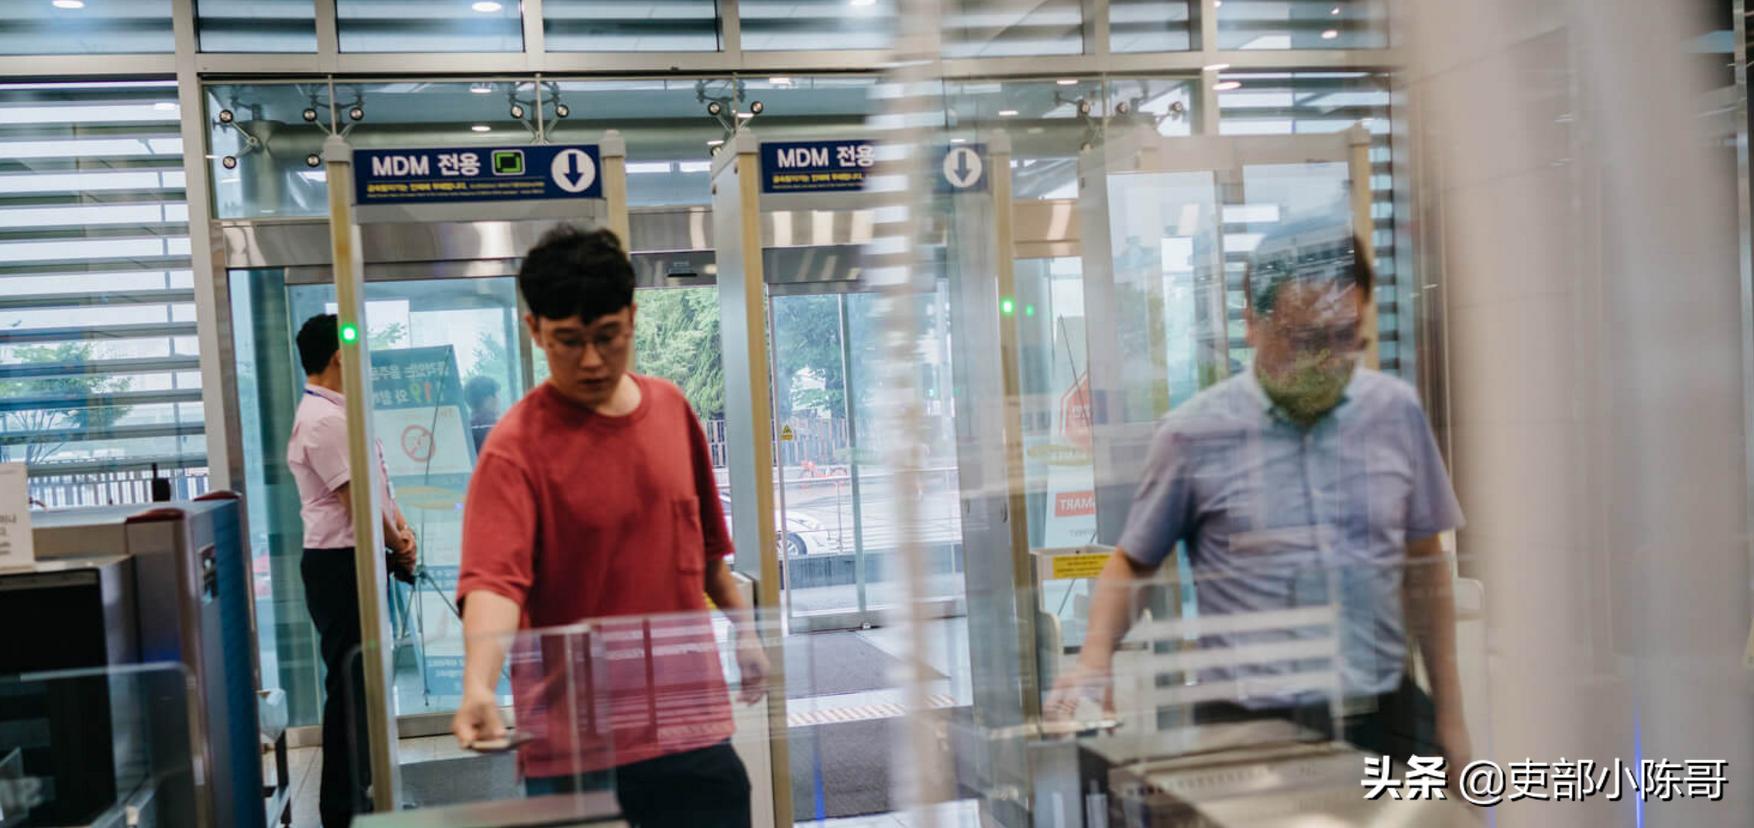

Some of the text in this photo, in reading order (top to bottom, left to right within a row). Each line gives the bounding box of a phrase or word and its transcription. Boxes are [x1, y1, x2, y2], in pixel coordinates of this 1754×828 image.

[372, 153, 481, 177] MDM 전용
[777, 145, 876, 168] MDM 전용
